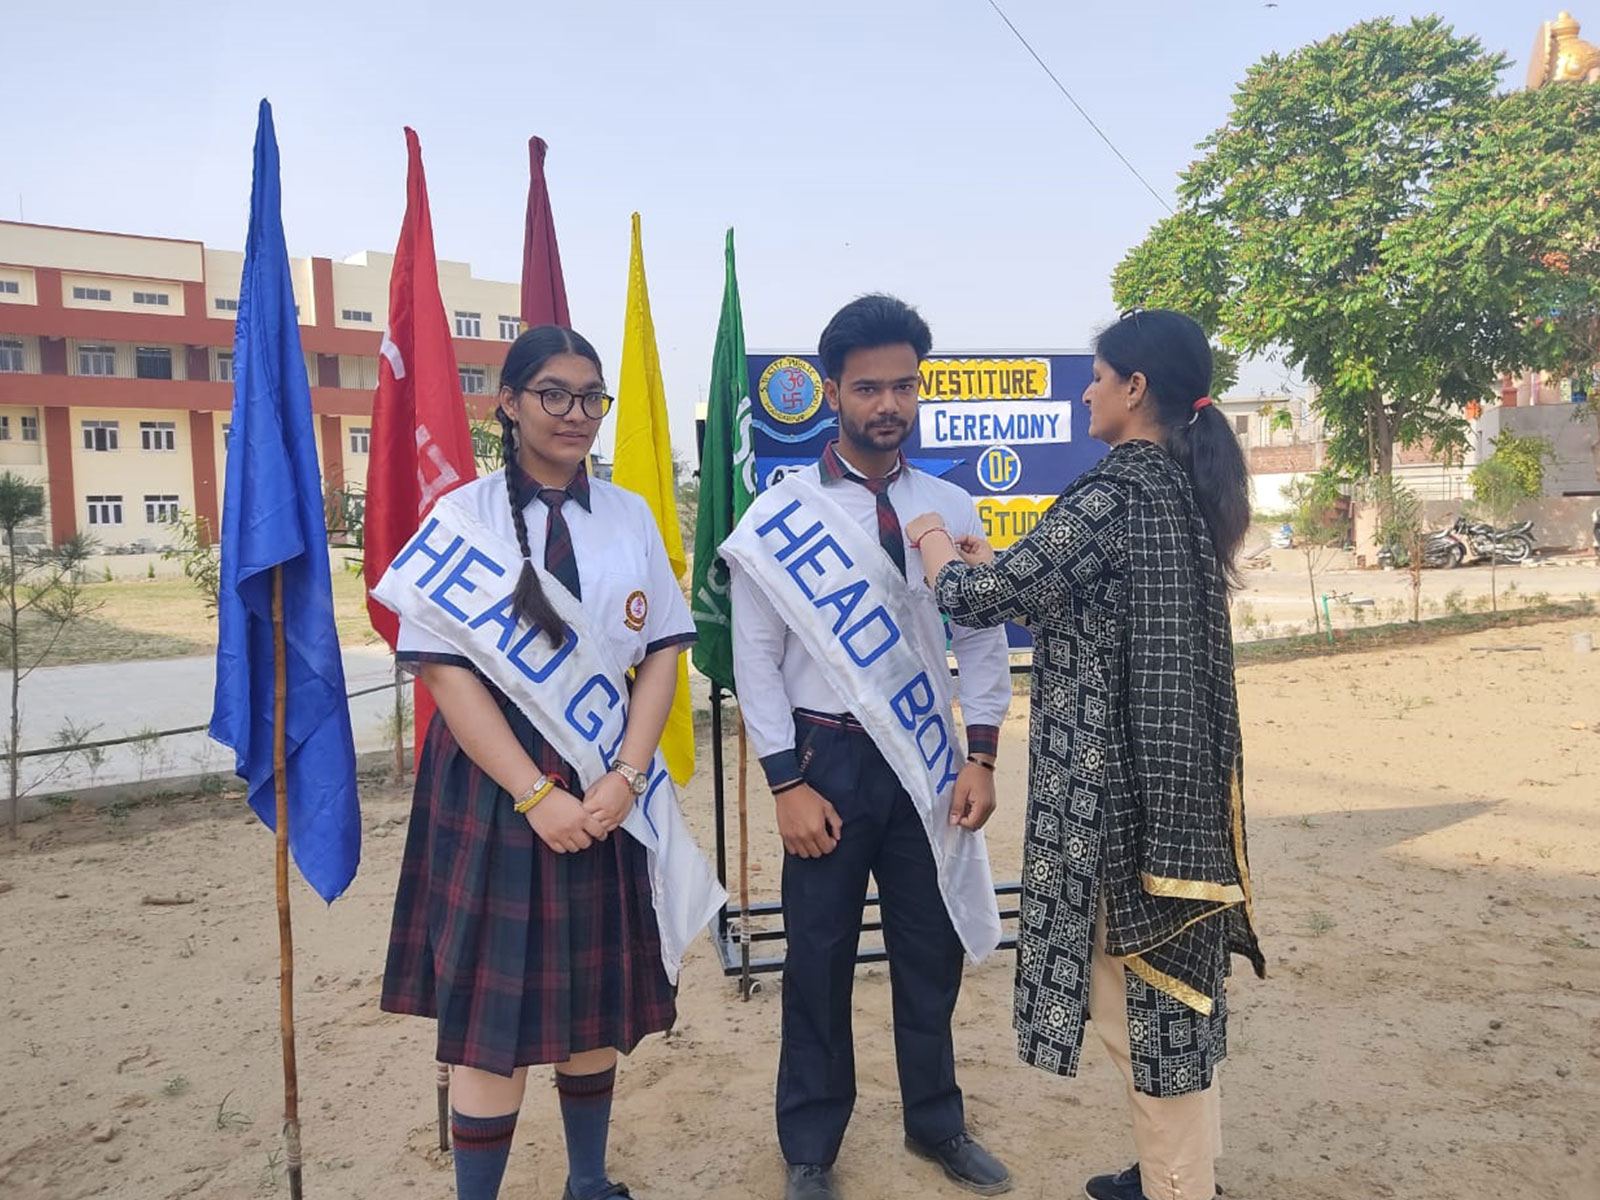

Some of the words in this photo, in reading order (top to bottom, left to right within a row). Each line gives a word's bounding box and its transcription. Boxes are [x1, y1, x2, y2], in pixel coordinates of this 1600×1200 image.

[935, 410, 1060, 442] CEREMONY
[989, 451, 1015, 484] OF
[391, 517, 579, 683] HEAD
[564, 673, 668, 842] GIL
[755, 499, 901, 668] HEAD
[889, 671, 958, 795] BOY
